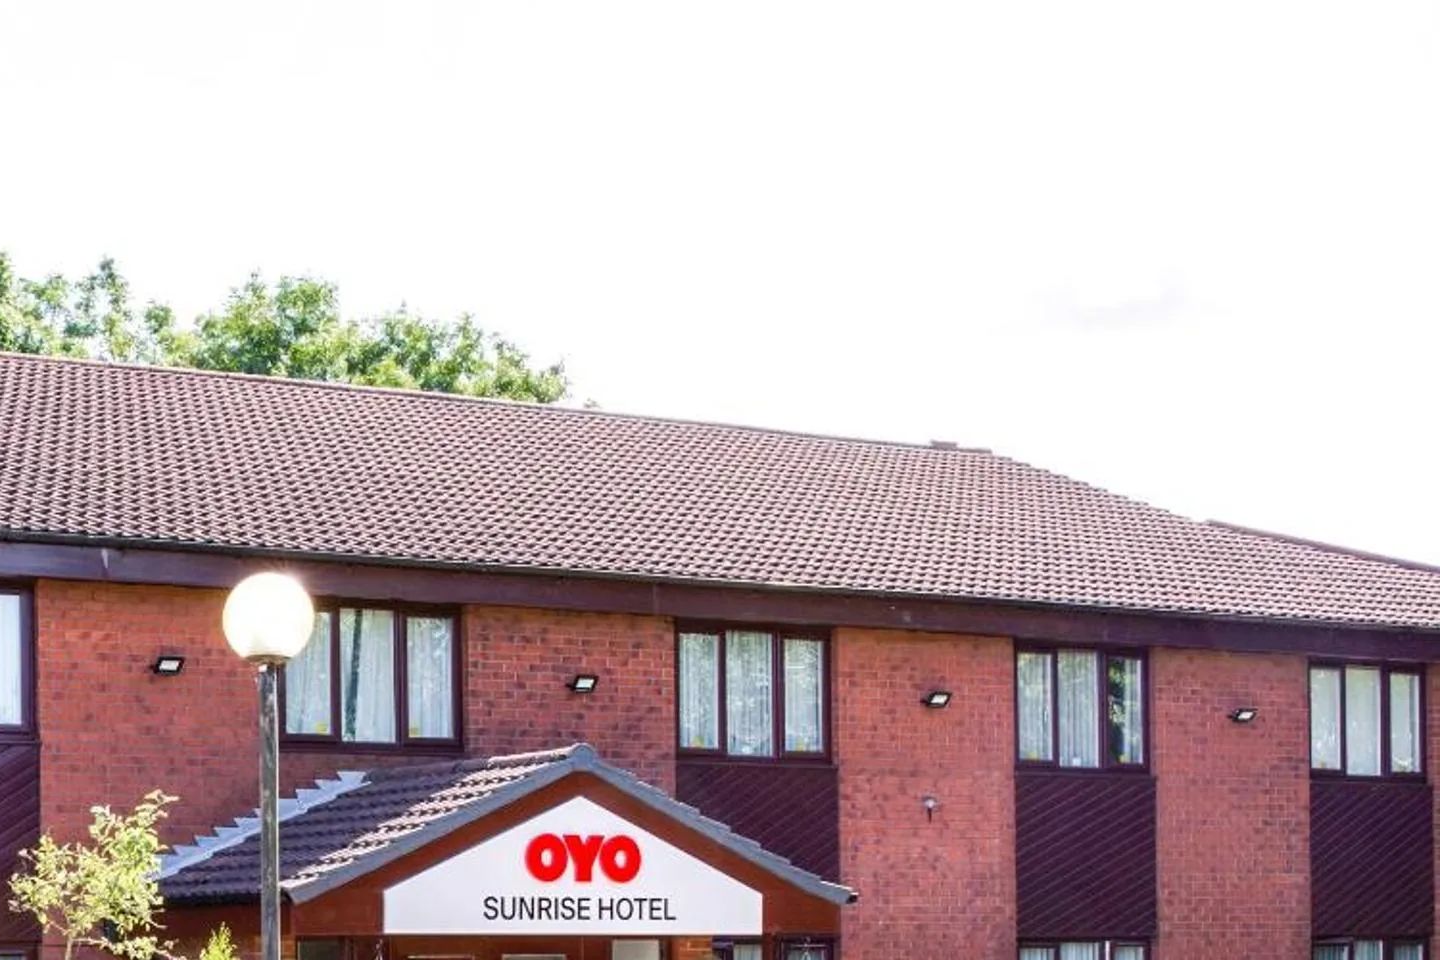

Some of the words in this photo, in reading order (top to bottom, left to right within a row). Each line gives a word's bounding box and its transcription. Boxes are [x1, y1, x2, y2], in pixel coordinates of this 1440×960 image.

[524, 833, 642, 884] OYO
[483, 896, 590, 921] SUNRISE
[598, 897, 676, 921] HOTEL
